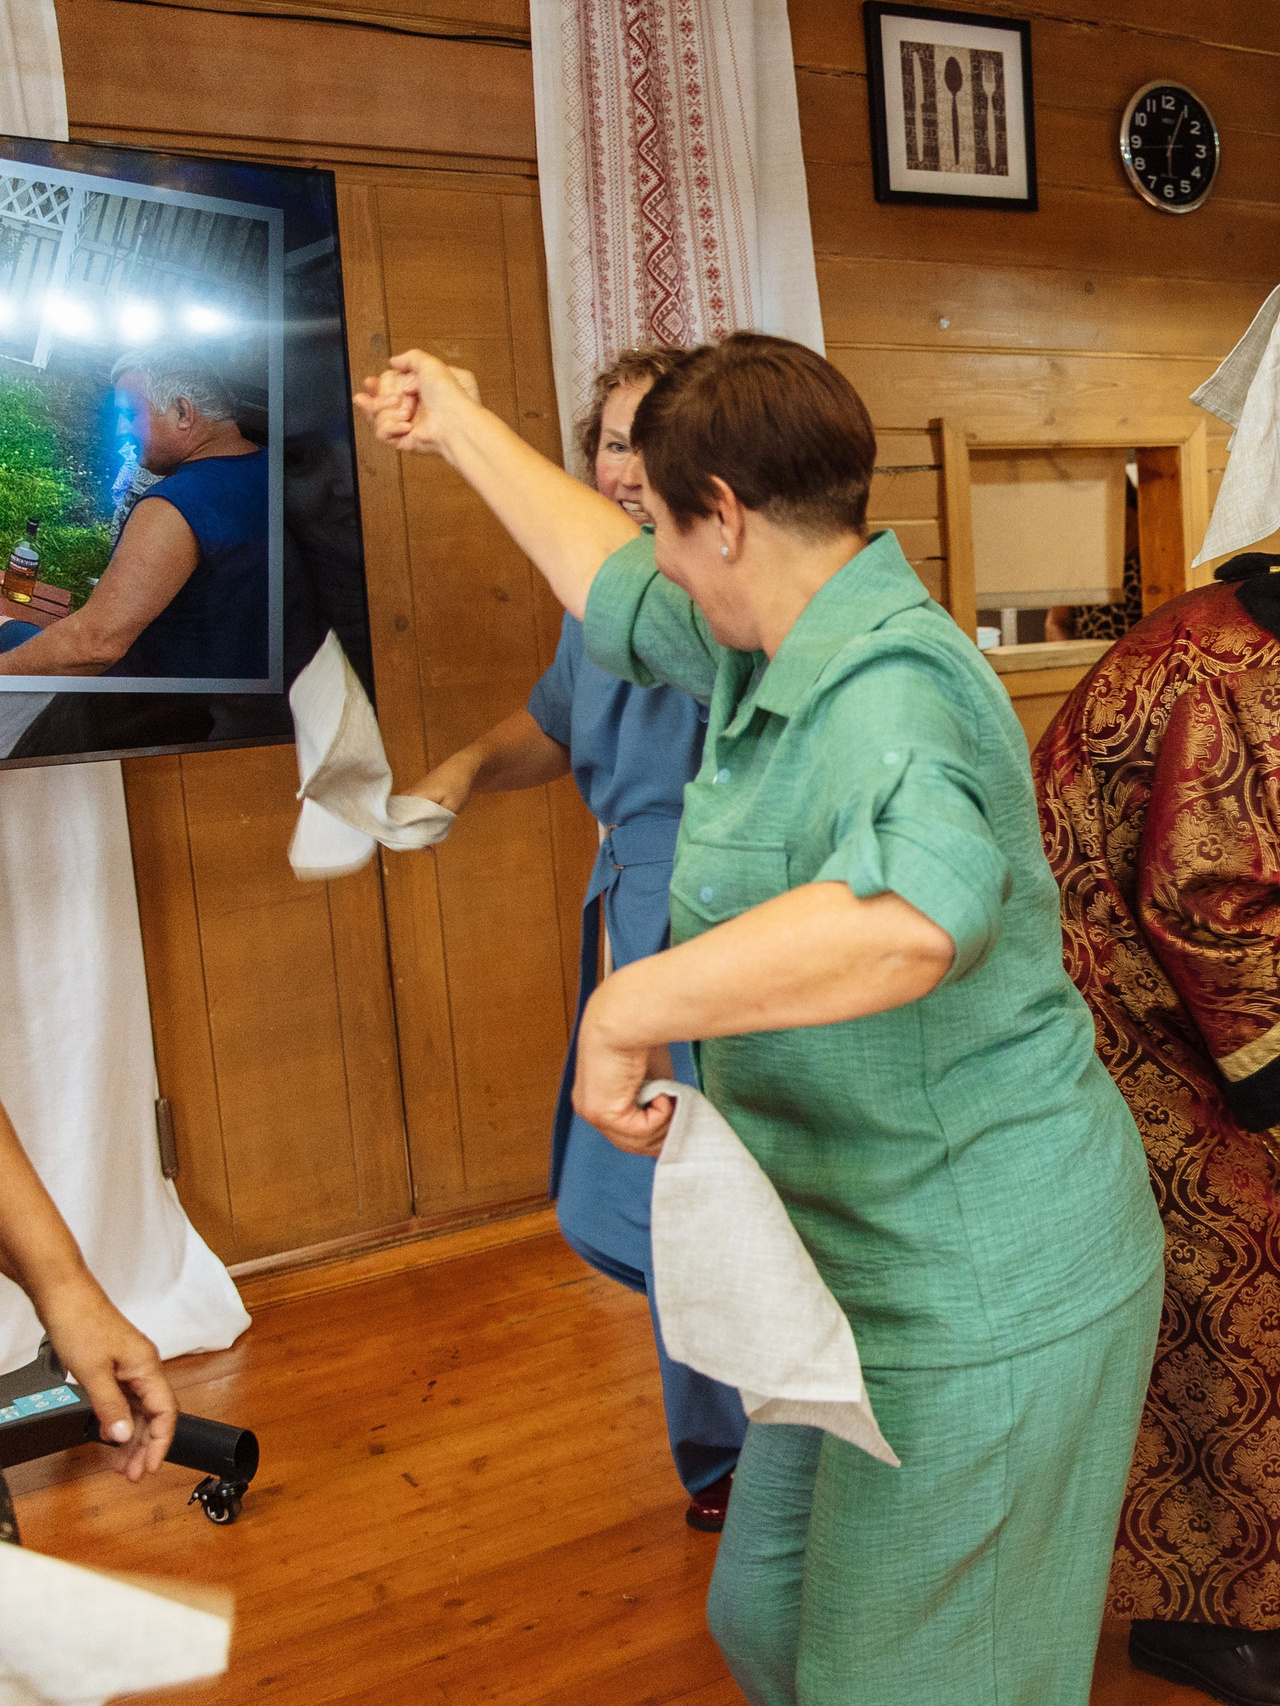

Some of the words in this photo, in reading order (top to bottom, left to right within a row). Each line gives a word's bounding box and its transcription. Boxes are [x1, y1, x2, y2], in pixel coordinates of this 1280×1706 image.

[1146, 98, 1156, 113] 11
[1161, 95, 1175, 110] 12
[1183, 105, 1189, 118] 1
[1135, 113, 1147, 127] 10
[1190, 121, 1201, 135] 2
[1131, 135, 1141, 148] 9
[1195, 145, 1207, 158] 3
[1134, 157, 1145, 170] 8
[1191, 166, 1202, 179] 4
[1147, 176, 1158, 189] 7
[1180, 180, 1191, 193] 5
[1163, 185, 1175, 198] 6
